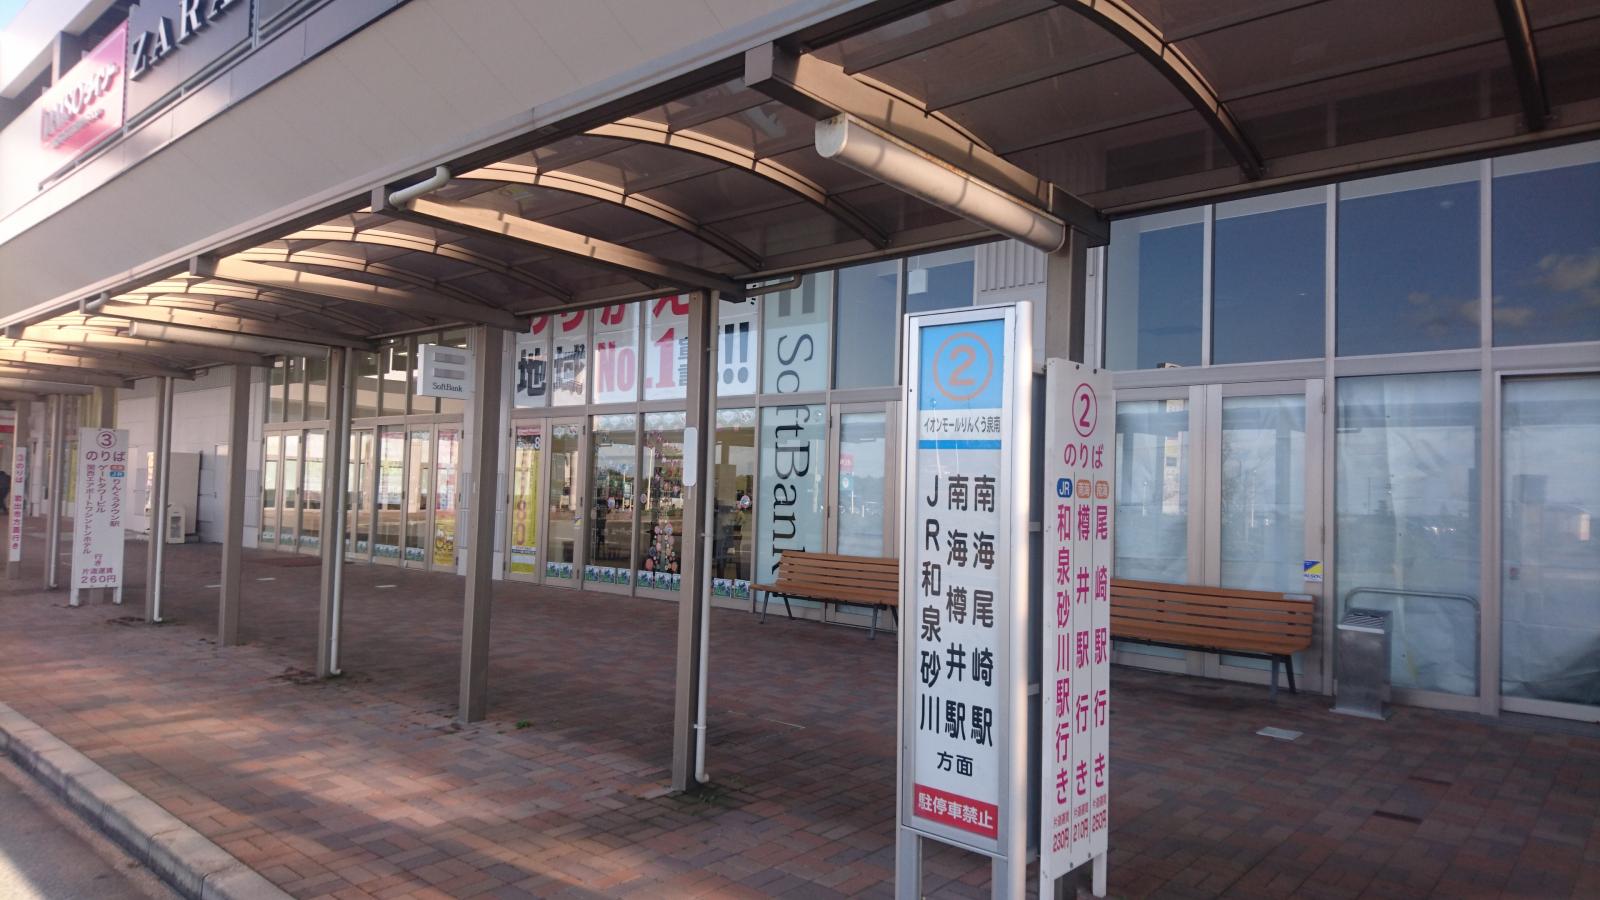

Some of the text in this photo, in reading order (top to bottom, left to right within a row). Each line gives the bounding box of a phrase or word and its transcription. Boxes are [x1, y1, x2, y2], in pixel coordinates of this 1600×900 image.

[129, 0, 237, 81] ZAR
[432, 382, 463, 393] SoftBank
[924, 416, 1001, 433] イオンモールりんくう泉南
[86, 450, 127, 461] のりば
[1064, 443, 1104, 469] のりば
[81, 575, 116, 584] 260円
[944, 473, 969, 741] 南海樽井駅
[970, 474, 996, 747] 南海尾崎駅
[1056, 504, 1071, 804] 和泉砂川駅行き
[1075, 504, 1091, 796] 樽井駅行き
[1093, 505, 1108, 788] 尾崎駅行き
[937, 751, 974, 777] 方面
[918, 792, 994, 830] 駐停車禁止
